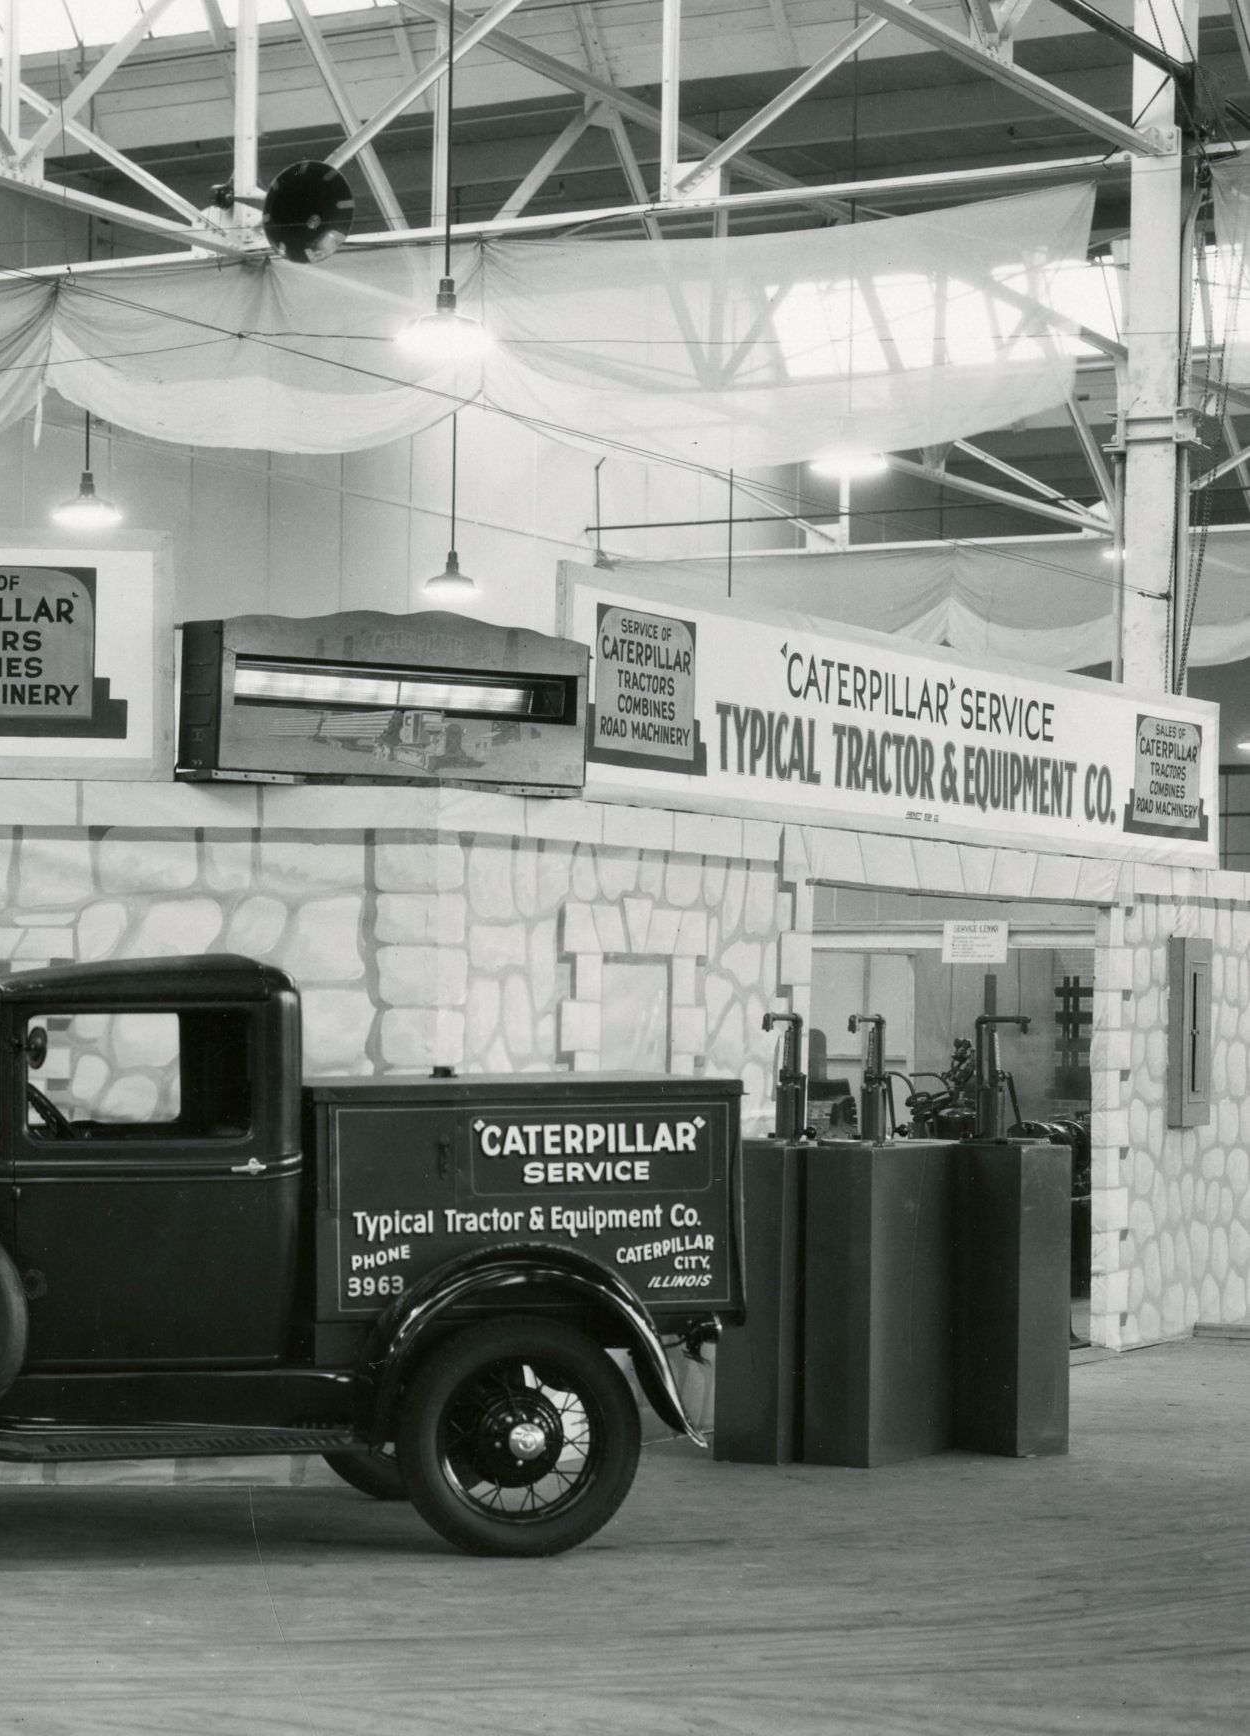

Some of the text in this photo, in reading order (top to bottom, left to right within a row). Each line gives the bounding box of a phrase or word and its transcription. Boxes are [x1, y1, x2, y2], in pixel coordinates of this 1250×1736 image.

[621, 618, 672, 641] SERVICE OF
[617, 669, 675, 697] TRACTORS
[617, 693, 675, 721] COMBINES
[960, 688, 1054, 742] SERVICE
[599, 715, 691, 747] ROAD MACHINERY
[1155, 724, 1186, 739] SALES OF
[715, 700, 1117, 826] TYPICAL TRACTOR & EQUIPMENT CO.
[1150, 762, 1186, 782] TRACTORS
[1149, 780, 1185, 799] COMBINES
[1136, 797, 1198, 819] ROAD MACHINERY
[523, 1161, 650, 1184] SERVICE
[353, 1203, 702, 1241] Typical Tractor & Equipment Co.
[351, 1245, 411, 1271] PHONE
[616, 1234, 715, 1264] CATERPILLAR
[674, 1255, 710, 1270] CITY,
[348, 1276, 404, 1297] 3963
[648, 1274, 712, 1289] ILLINOIS
